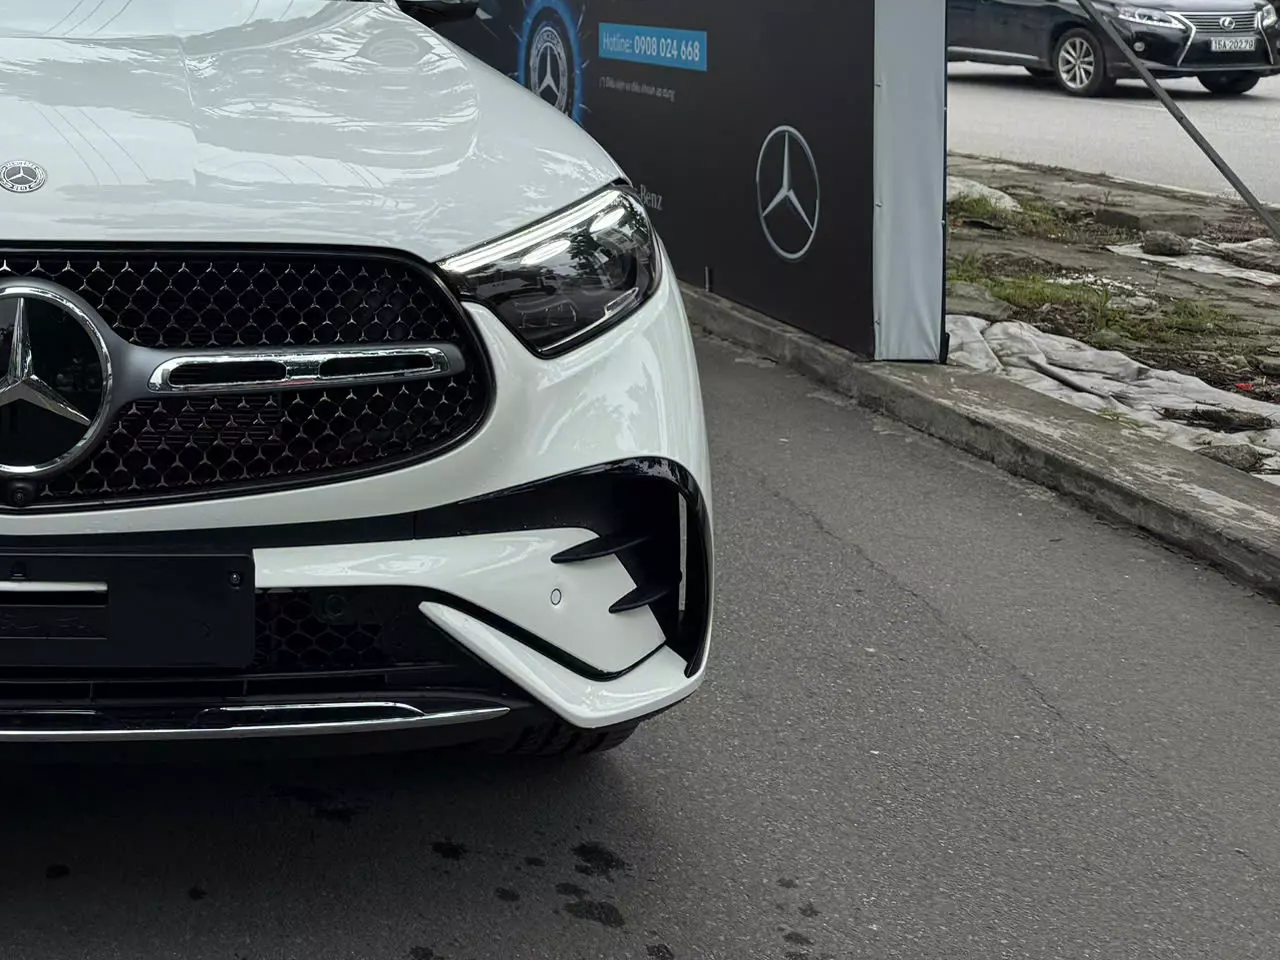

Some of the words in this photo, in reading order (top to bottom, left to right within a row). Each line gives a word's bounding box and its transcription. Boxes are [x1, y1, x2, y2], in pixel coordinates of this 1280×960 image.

[602, 31, 633, 54] Hotline:
[634, 35, 658, 57] 0908
[659, 38, 678, 60] 024
[680, 40, 700, 62] 668
